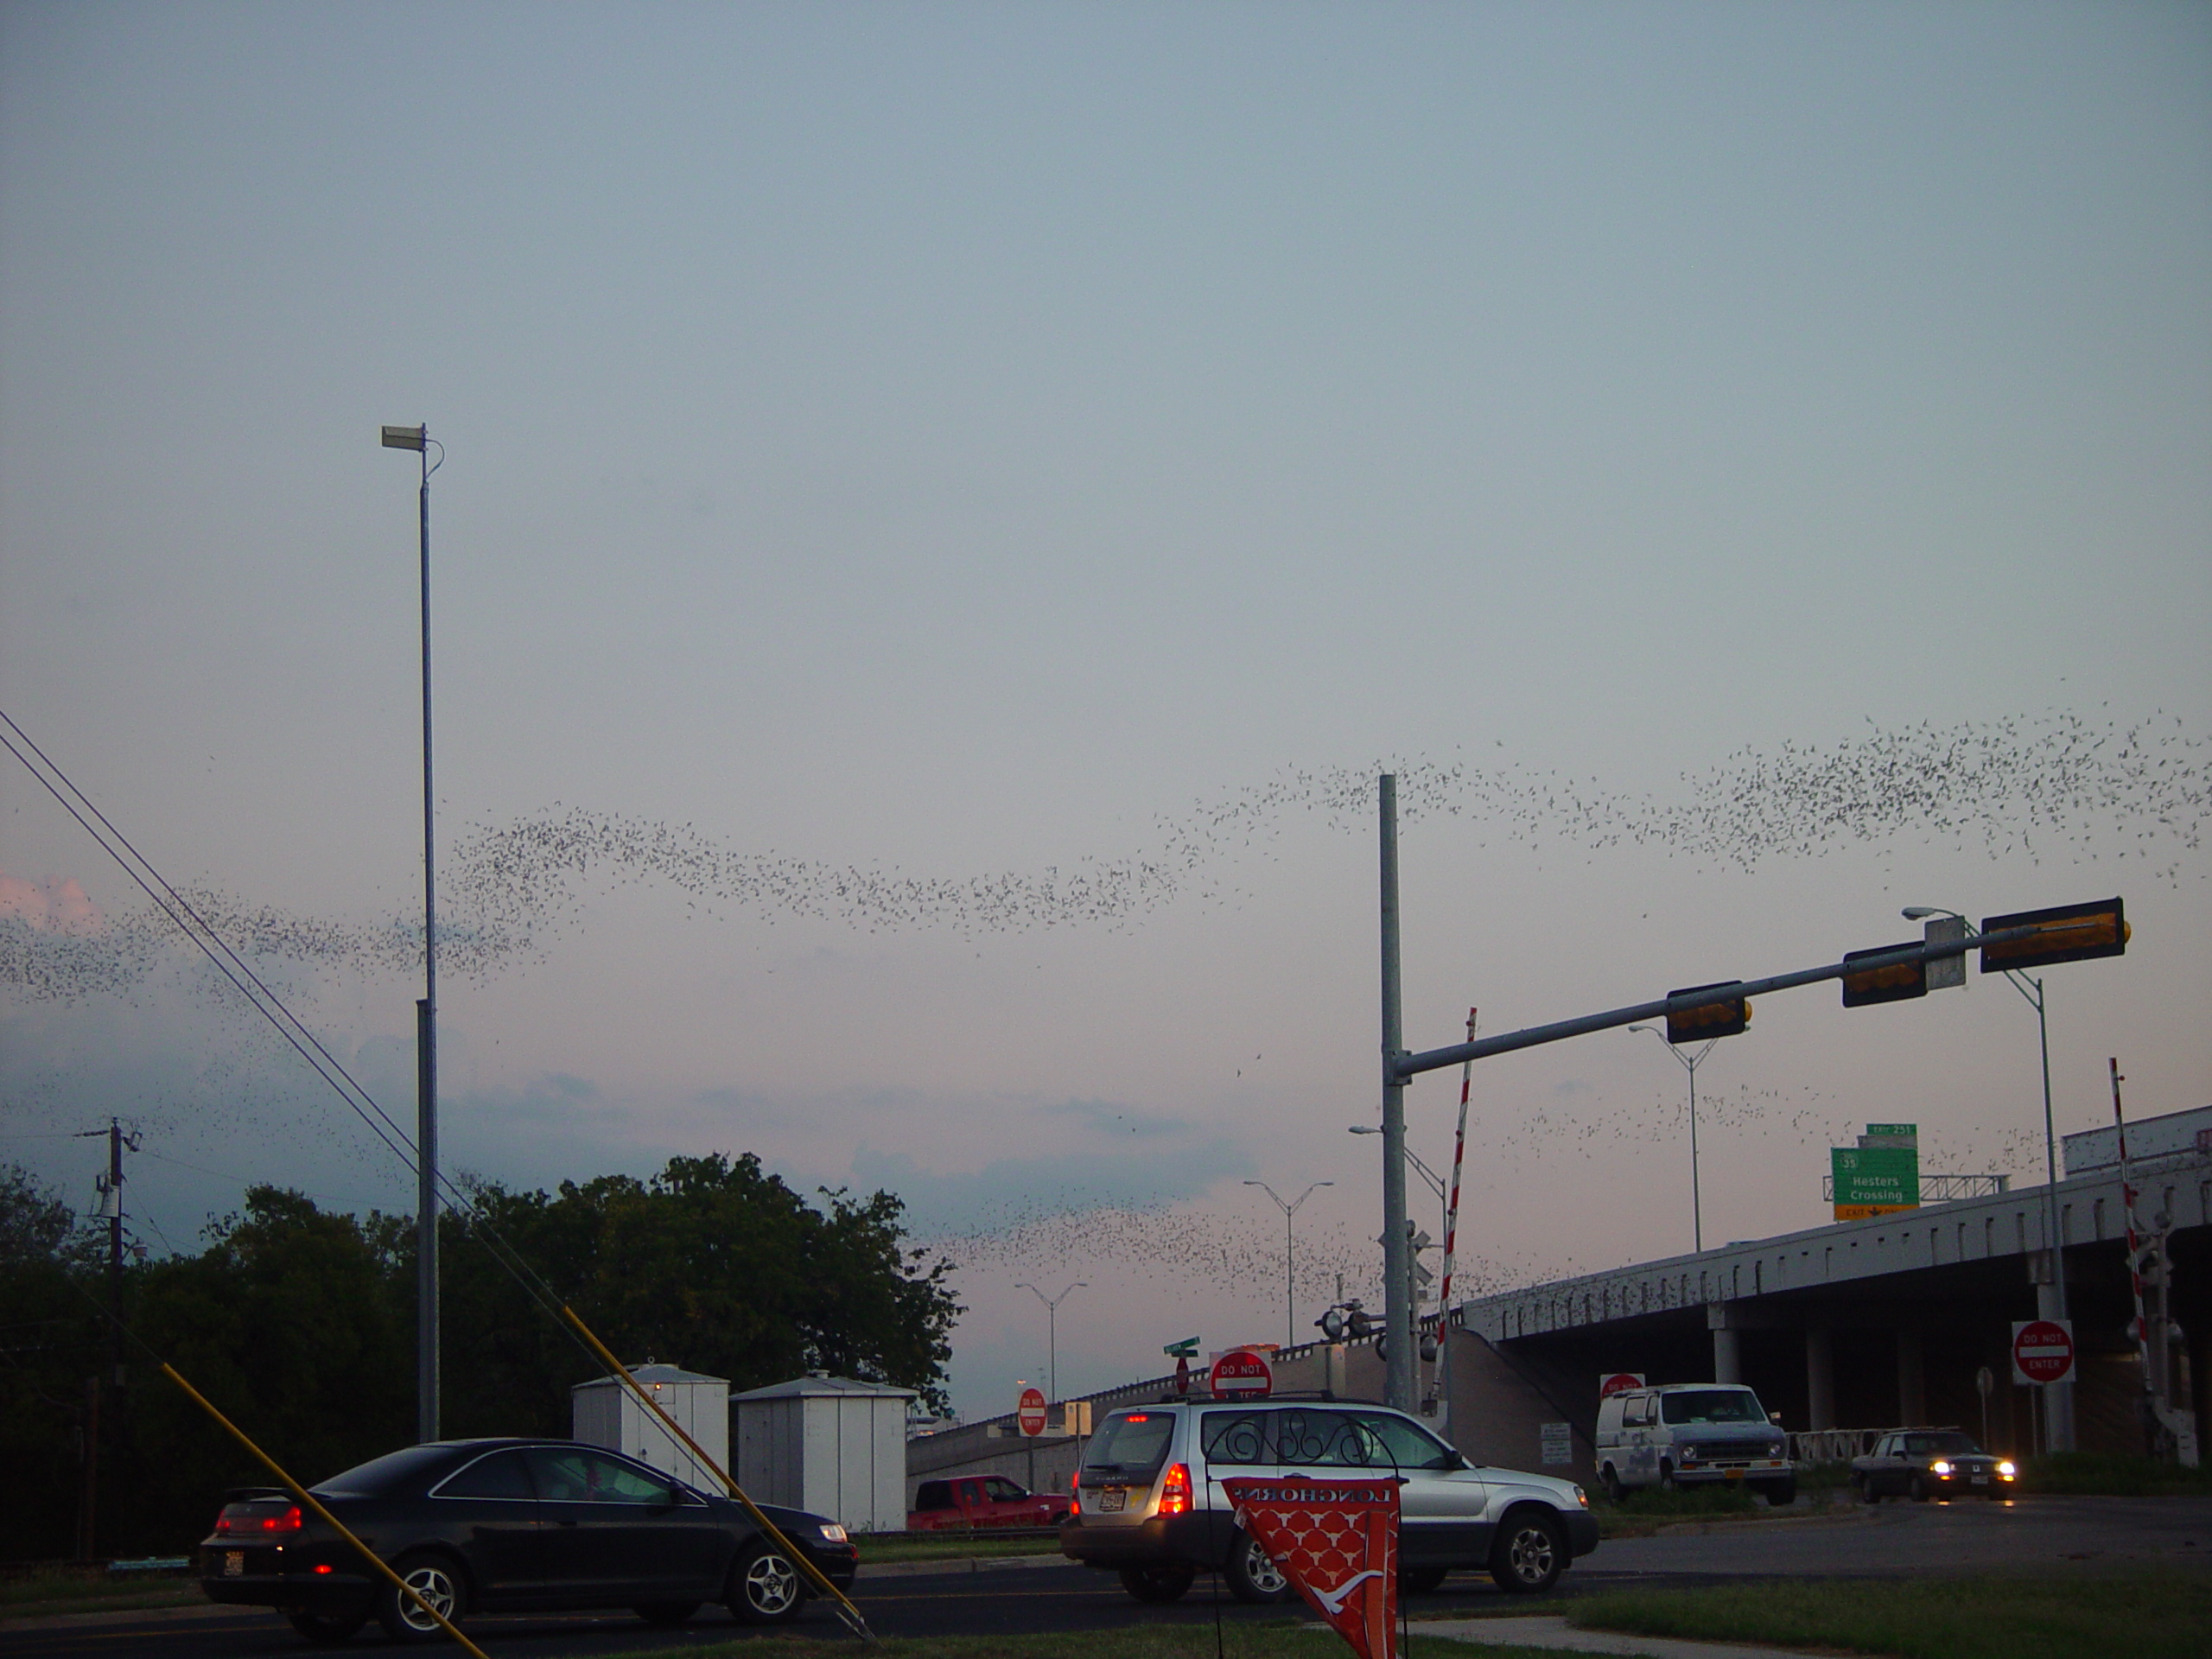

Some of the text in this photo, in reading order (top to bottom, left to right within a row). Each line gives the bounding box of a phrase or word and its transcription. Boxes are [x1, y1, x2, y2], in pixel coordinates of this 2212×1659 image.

[1843, 1159, 1856, 1168] 35
[1853, 1177, 1898, 1186] Hesters
[1850, 1190, 1903, 1202] Crossing
[2043, 1334, 2062, 1343] NOT
[1221, 1364, 1261, 1375] DO NOT
[2029, 1360, 2060, 1370] ENTER
